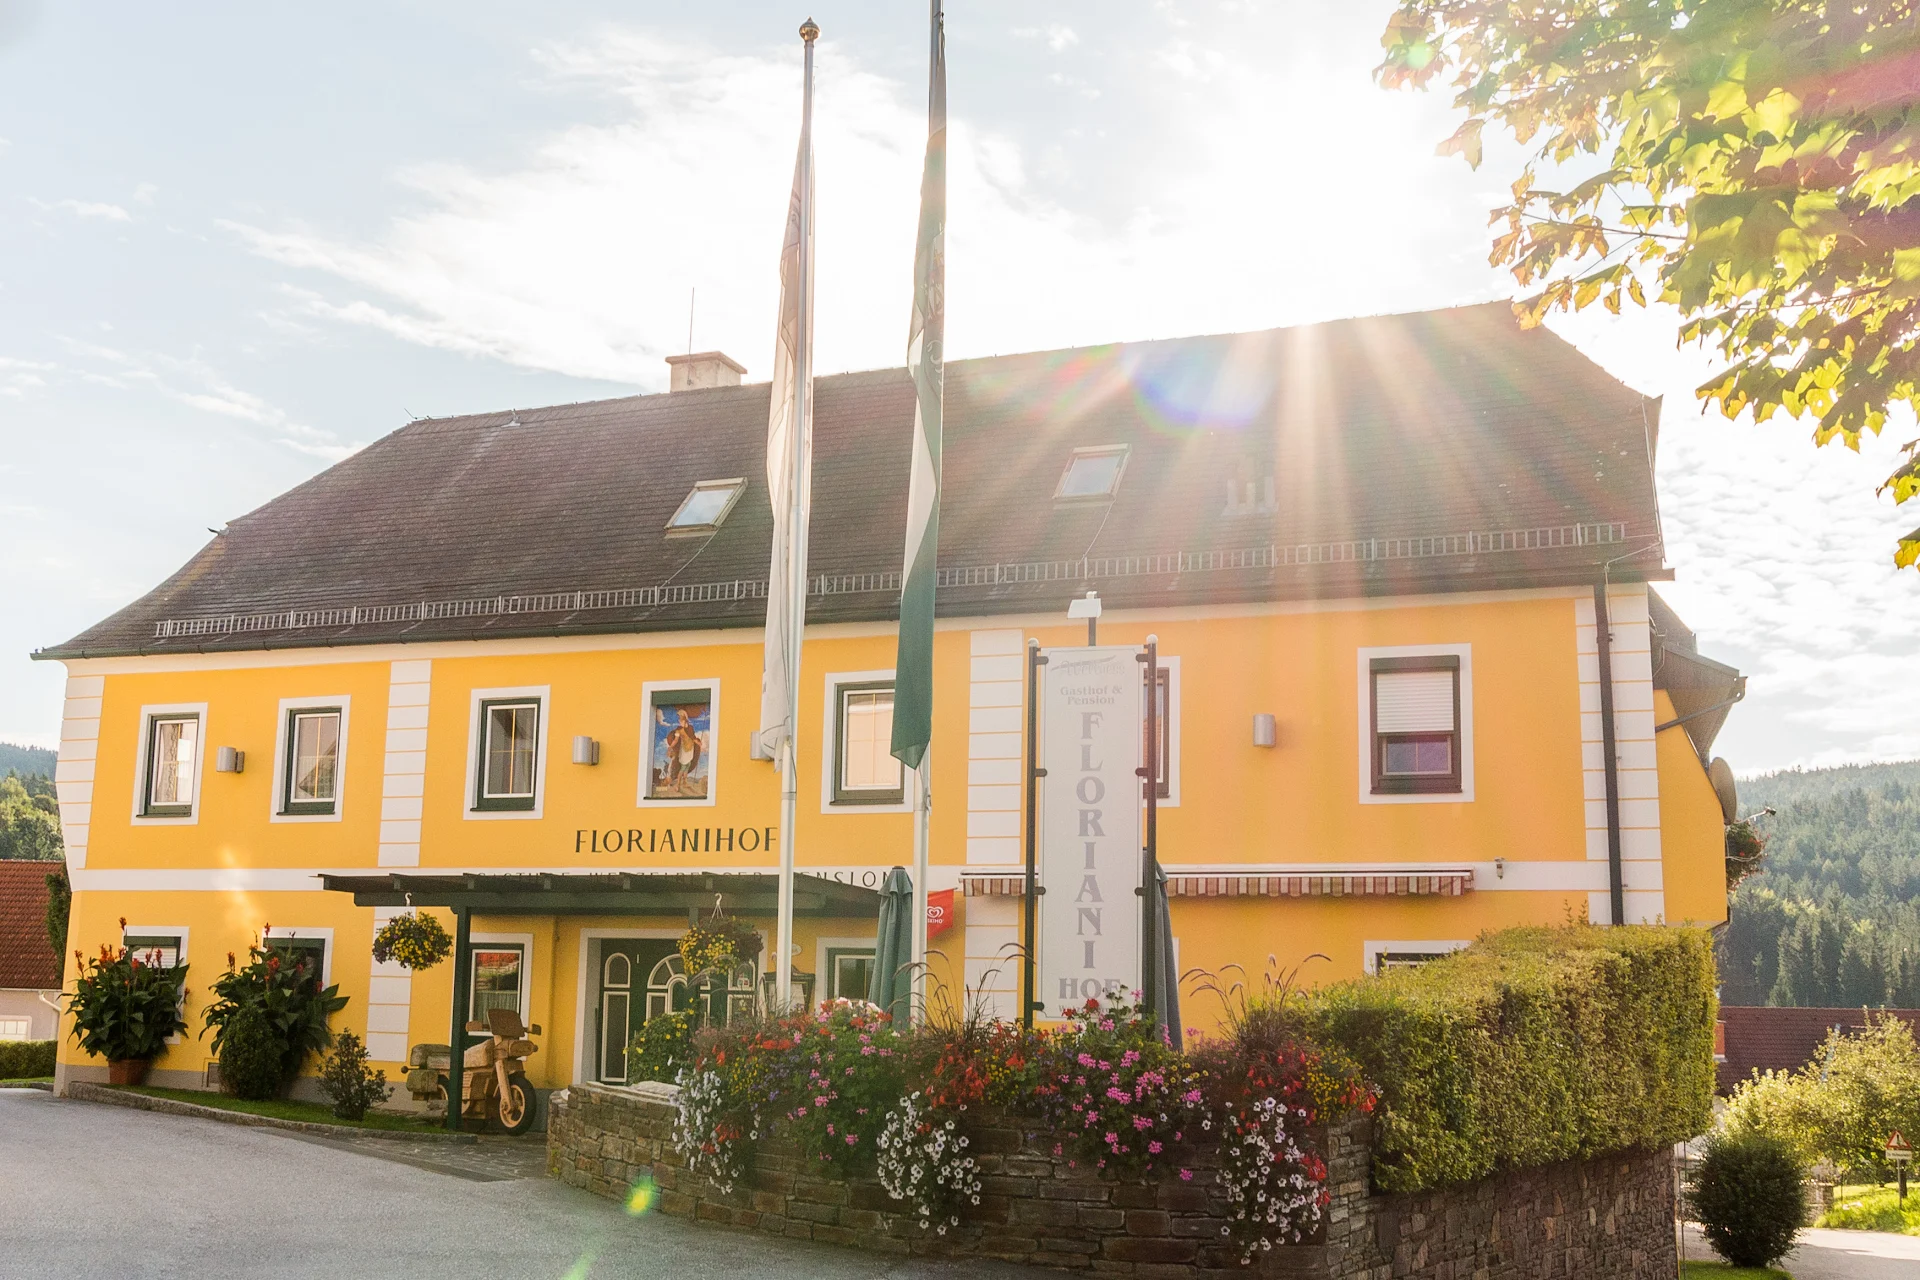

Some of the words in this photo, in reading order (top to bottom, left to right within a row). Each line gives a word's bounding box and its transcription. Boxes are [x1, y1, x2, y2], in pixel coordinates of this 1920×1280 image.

[1060, 685, 1108, 696] Gasthof
[1111, 685, 1123, 695] &
[1067, 695, 1115, 705] Pension
[575, 827, 778, 853] FLORIANIHOF
[1074, 711, 1106, 969] FLORIANI
